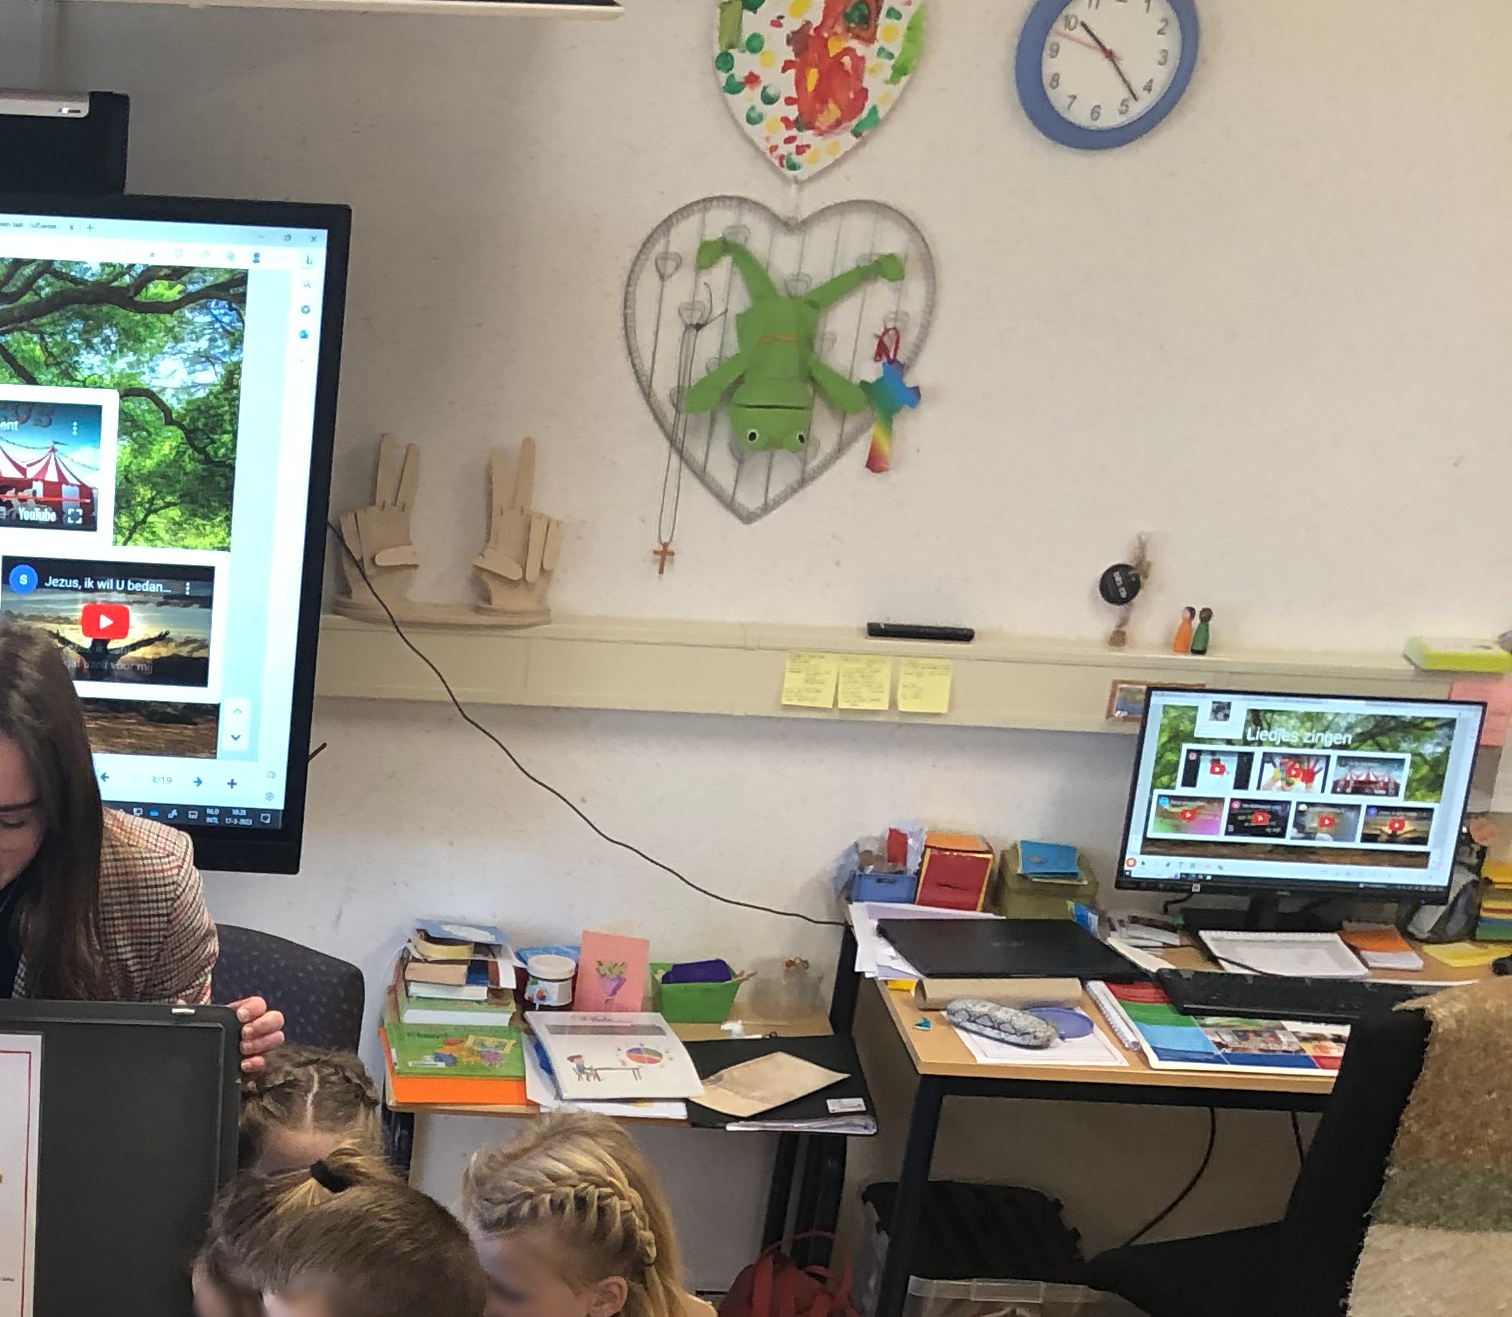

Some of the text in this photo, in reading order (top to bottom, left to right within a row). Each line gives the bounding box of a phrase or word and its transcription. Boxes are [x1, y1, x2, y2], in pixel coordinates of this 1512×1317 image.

[1063, 14, 1078, 31] 10
[1157, 18, 1169, 36] 2
[1049, 42, 1060, 58] 9
[1157, 49, 1168, 66] 3
[1049, 73, 1060, 90] 8
[1143, 78, 1153, 94] 4
[1066, 94, 1077, 111] 7
[1118, 98, 1129, 115] 5
[1090, 104, 1101, 121] 6
[18, 507, 57, 522] YouTube
[44, 575, 82, 590] Jezus,
[83, 576, 95, 589] ik
[97, 578, 114, 590] wil
[116, 579, 125, 591] U
[1246, 726, 1352, 748] Liedjes zingen
